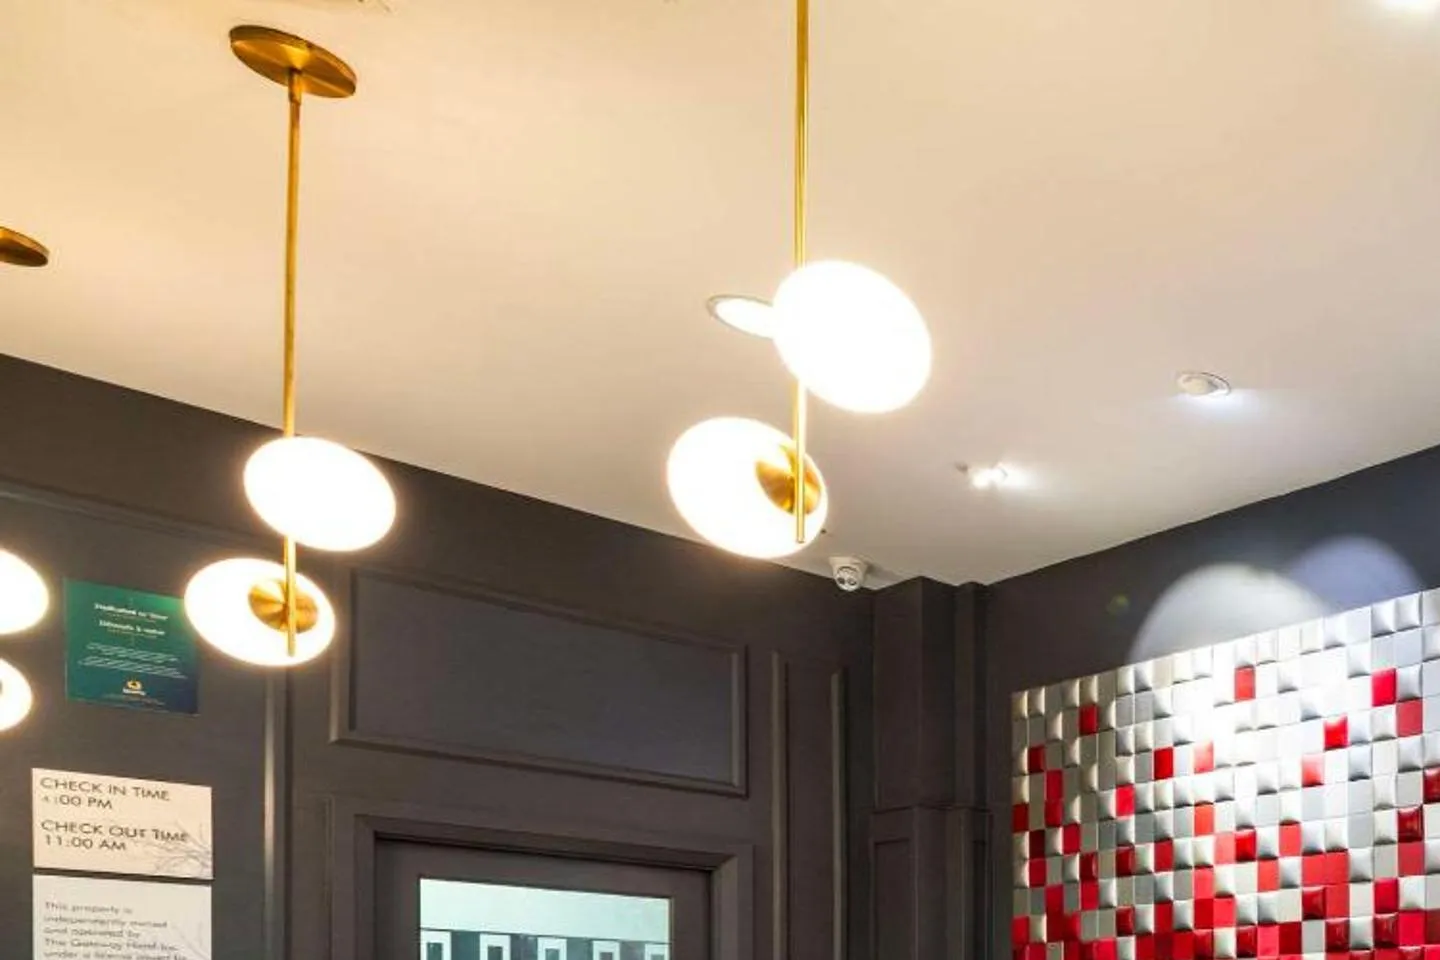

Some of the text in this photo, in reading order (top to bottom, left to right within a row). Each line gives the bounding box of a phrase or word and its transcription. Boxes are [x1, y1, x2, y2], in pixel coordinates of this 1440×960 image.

[40, 777, 170, 801] CHECK IN TIME
[88, 796, 113, 810] PM
[41, 819, 188, 842] CHECK OUT TIME
[99, 838, 127, 850] AM
